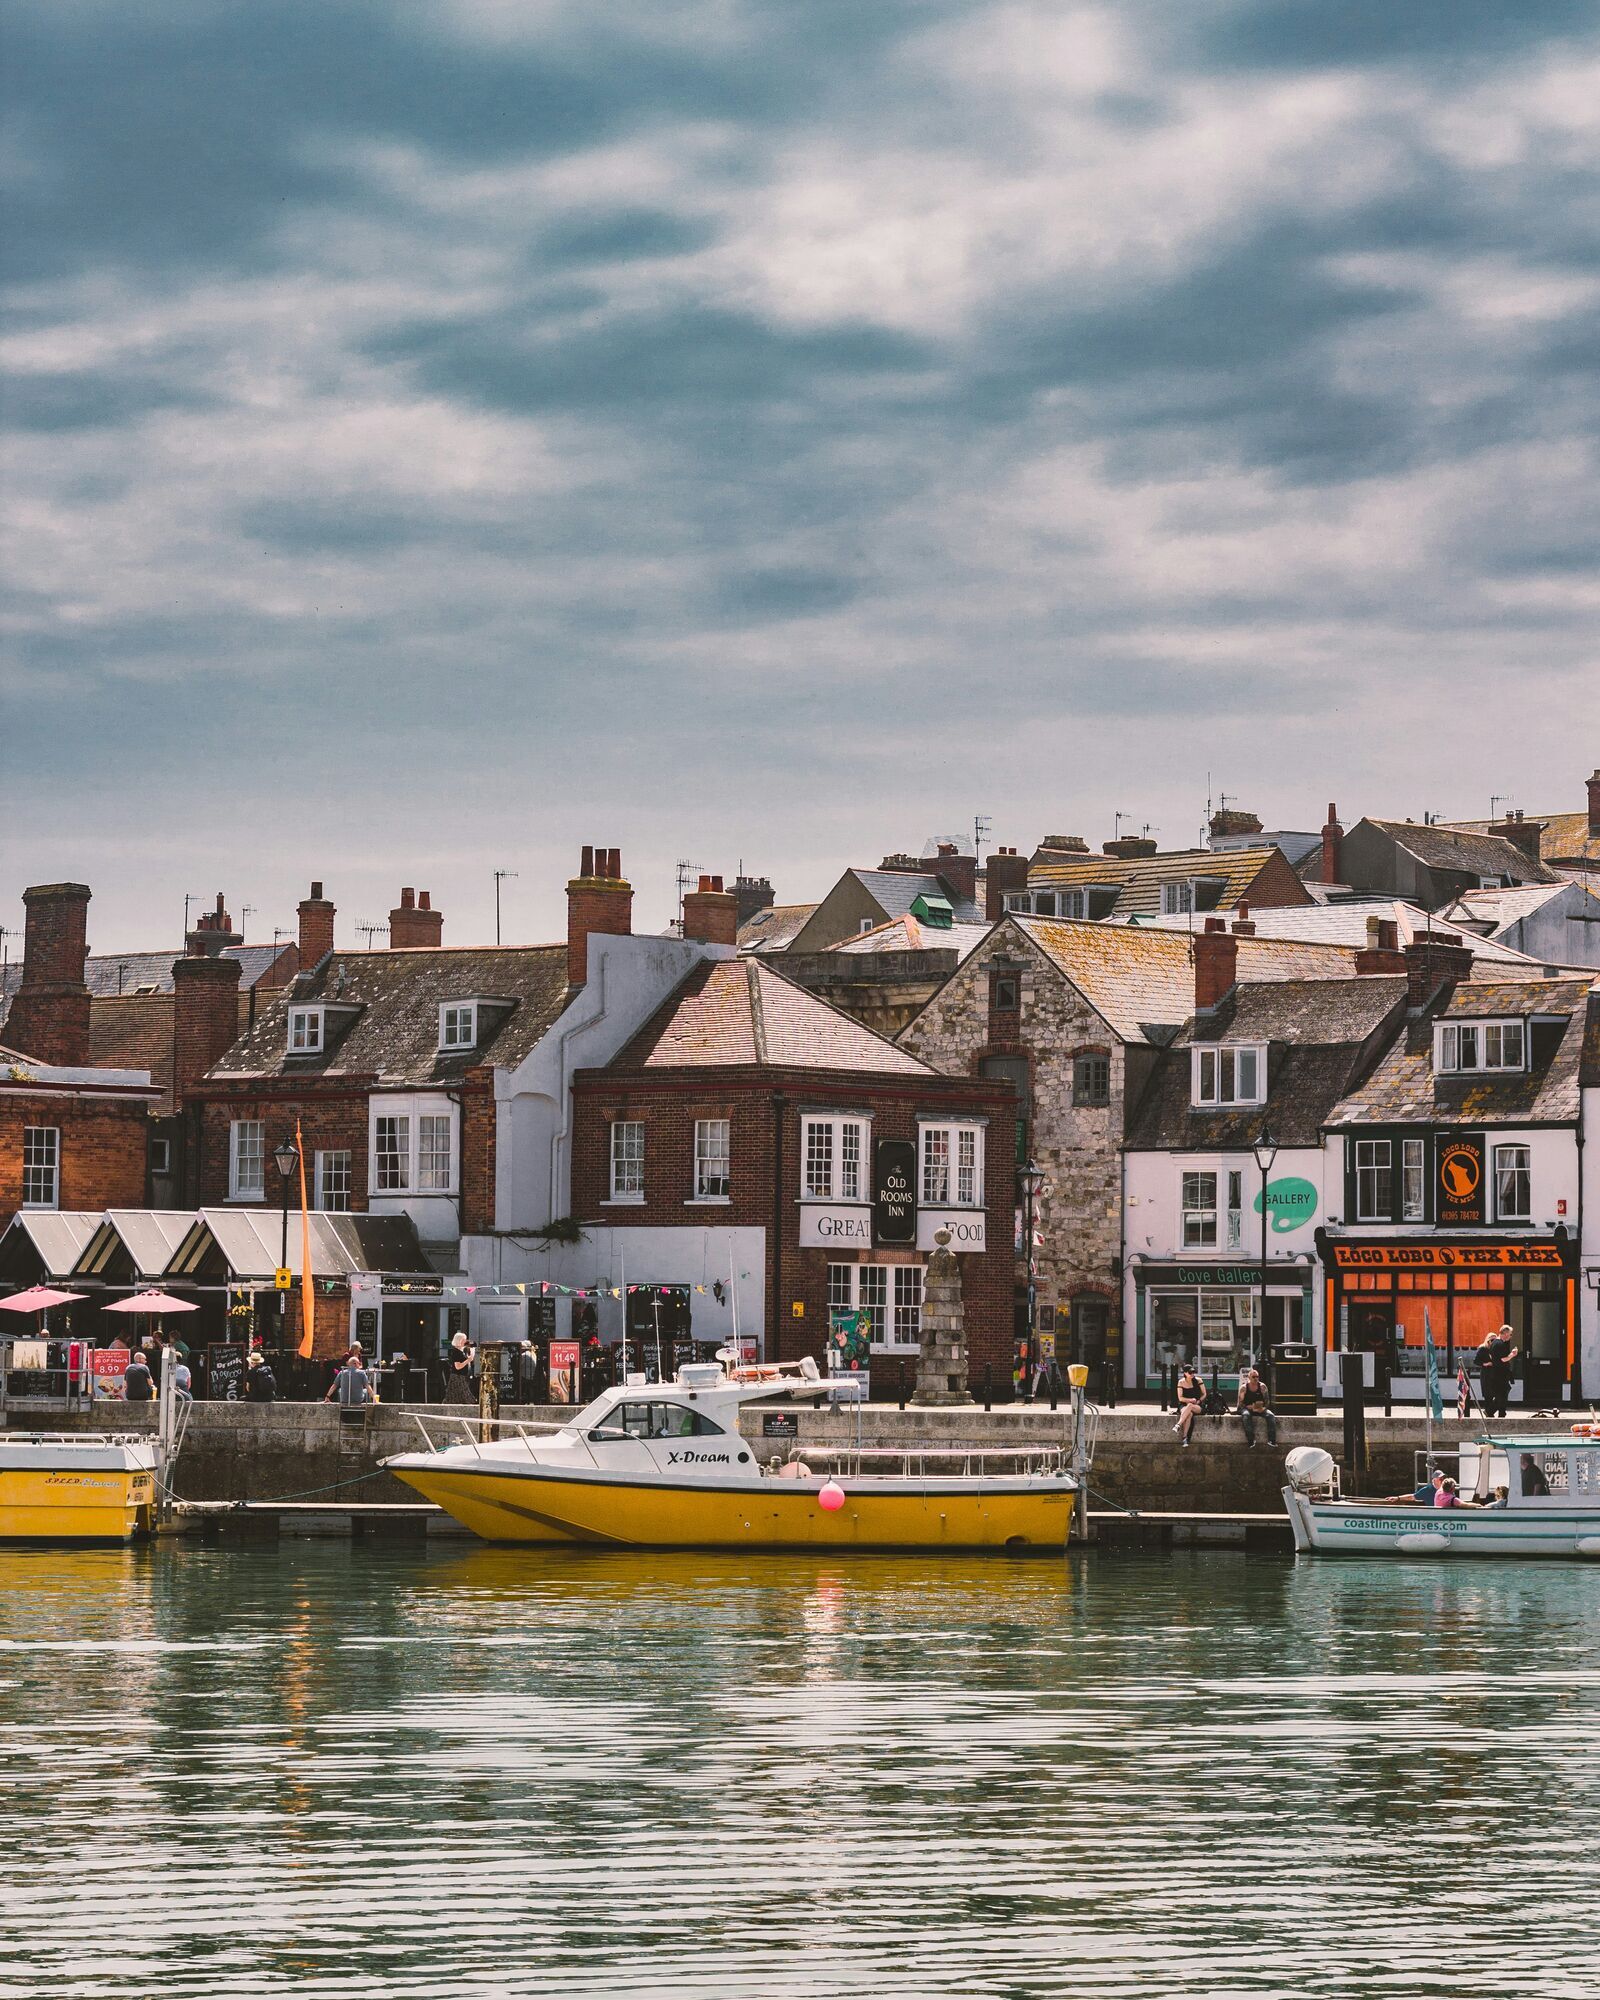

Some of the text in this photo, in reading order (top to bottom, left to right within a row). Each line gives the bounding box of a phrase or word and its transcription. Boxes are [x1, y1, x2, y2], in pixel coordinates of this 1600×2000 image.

[1441, 1143, 1480, 1158] LOCO LOBO
[887, 1175, 906, 1188] OLD
[880, 1190, 913, 1203] ROOMS
[1265, 1193, 1311, 1205] GALLERY
[1446, 1193, 1476, 1204] TEX MEX
[888, 1204, 905, 1217] INN
[818, 1216, 870, 1238] GREAT
[1338, 1249, 1560, 1263] LOCO LOBO TEX MEX
[1178, 1267, 1211, 1283] Cove
[216, 1357, 243, 1369] Drink
[554, 1352, 575, 1363] 11.49
[99, 1365, 120, 1374] 8.99
[667, 1450, 730, 1466] X-Dream
